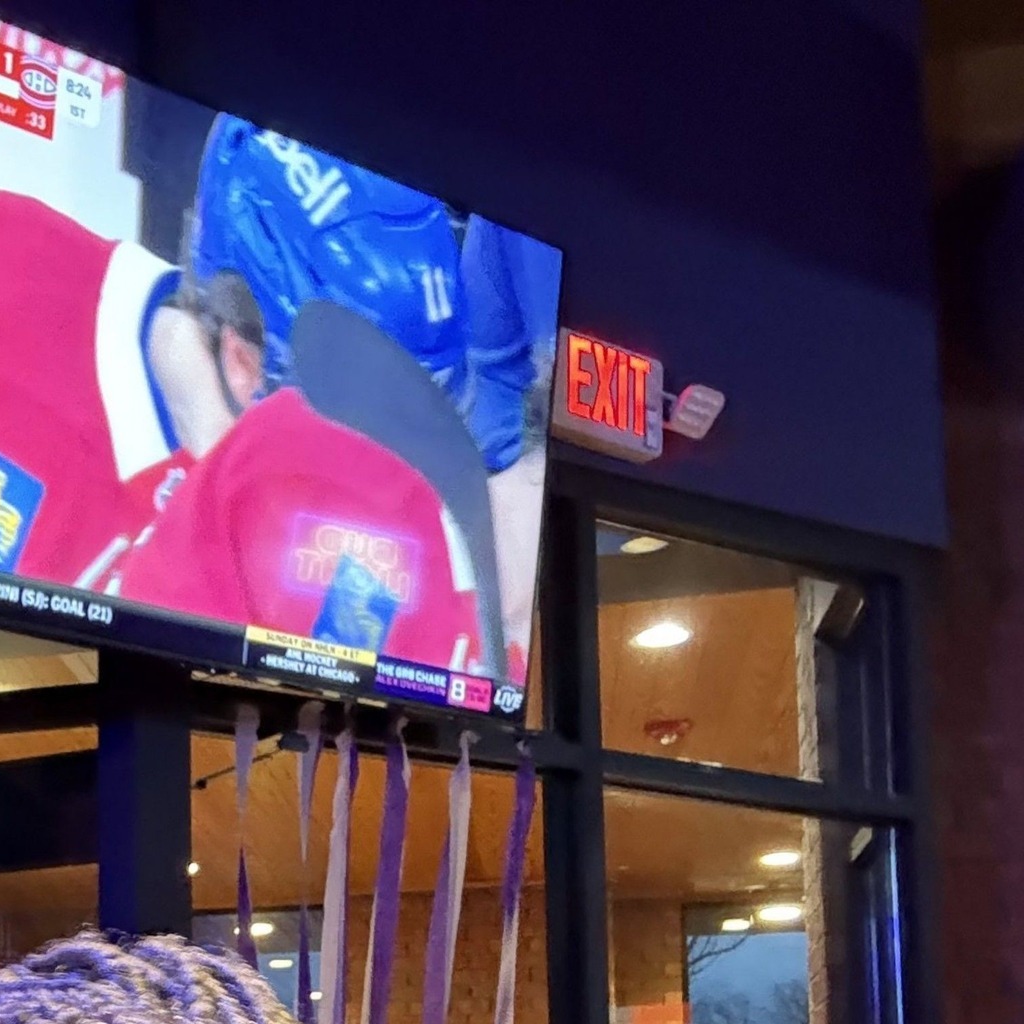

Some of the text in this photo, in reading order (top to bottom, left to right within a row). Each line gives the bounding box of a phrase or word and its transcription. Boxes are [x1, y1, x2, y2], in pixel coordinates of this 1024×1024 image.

[4, 52, 14, 74] 1
[66, 79, 92, 100] 8:24
[70, 105, 86, 120] 1ST
[567, 333, 651, 437] EXIT
[51, 598, 86, 618] GOAL
[87, 604, 113, 625] (21)
[451, 679, 466, 701] 8
[493, 688, 524, 710] LIVE
